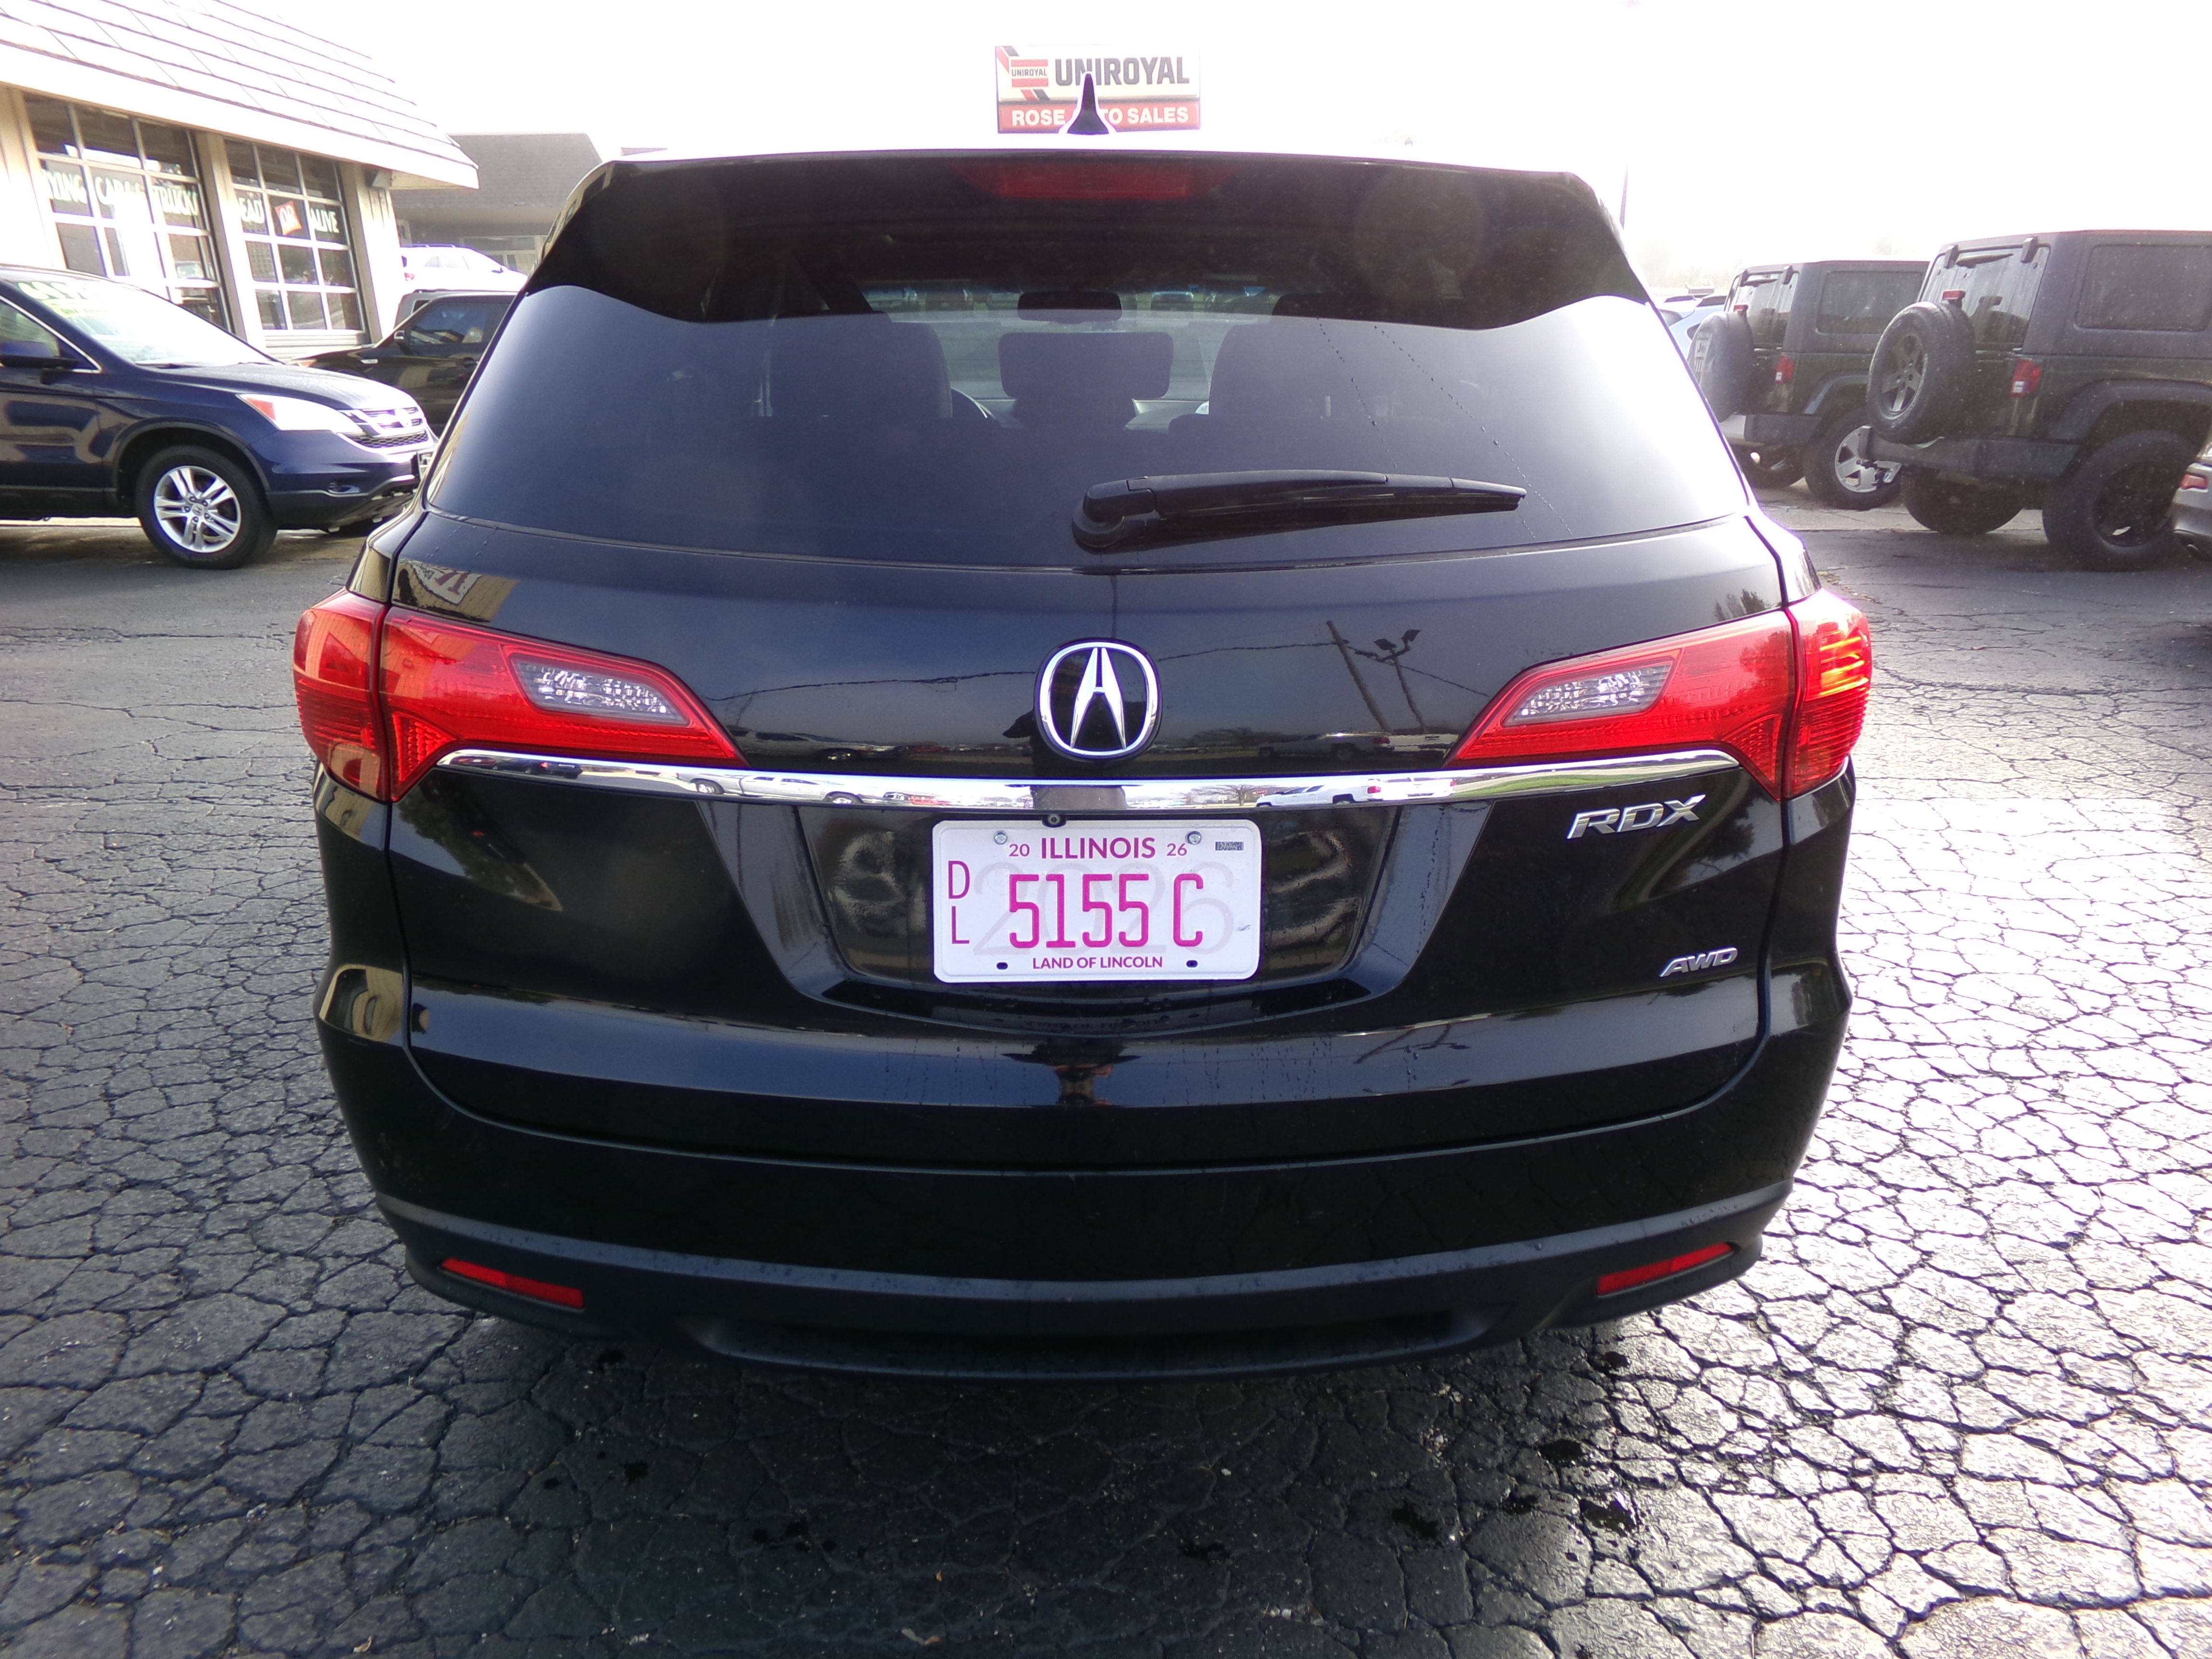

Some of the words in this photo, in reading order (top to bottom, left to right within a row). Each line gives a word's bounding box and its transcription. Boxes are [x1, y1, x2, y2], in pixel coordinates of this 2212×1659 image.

[1011, 69, 1047, 77] UNIROYAL
[1055, 57, 1190, 86] UNIROYAL
[1011, 109, 1066, 126] ROSE
[1127, 107, 1189, 124] SALES
[238, 197, 264, 224] EAD
[279, 204, 298, 228] OR
[1567, 794, 1706, 839] RDX
[1009, 843, 1030, 857] 20
[1042, 837, 1156, 859] ILLINOIS
[1166, 843, 1188, 856] 26
[1009, 873, 1150, 949] 5155
[1173, 873, 1204, 948] C
[1033, 958, 1073, 969] LAND
[1076, 957, 1097, 969] OF
[1100, 957, 1164, 969] LINCOLN
[1659, 946, 1738, 977] AWD
